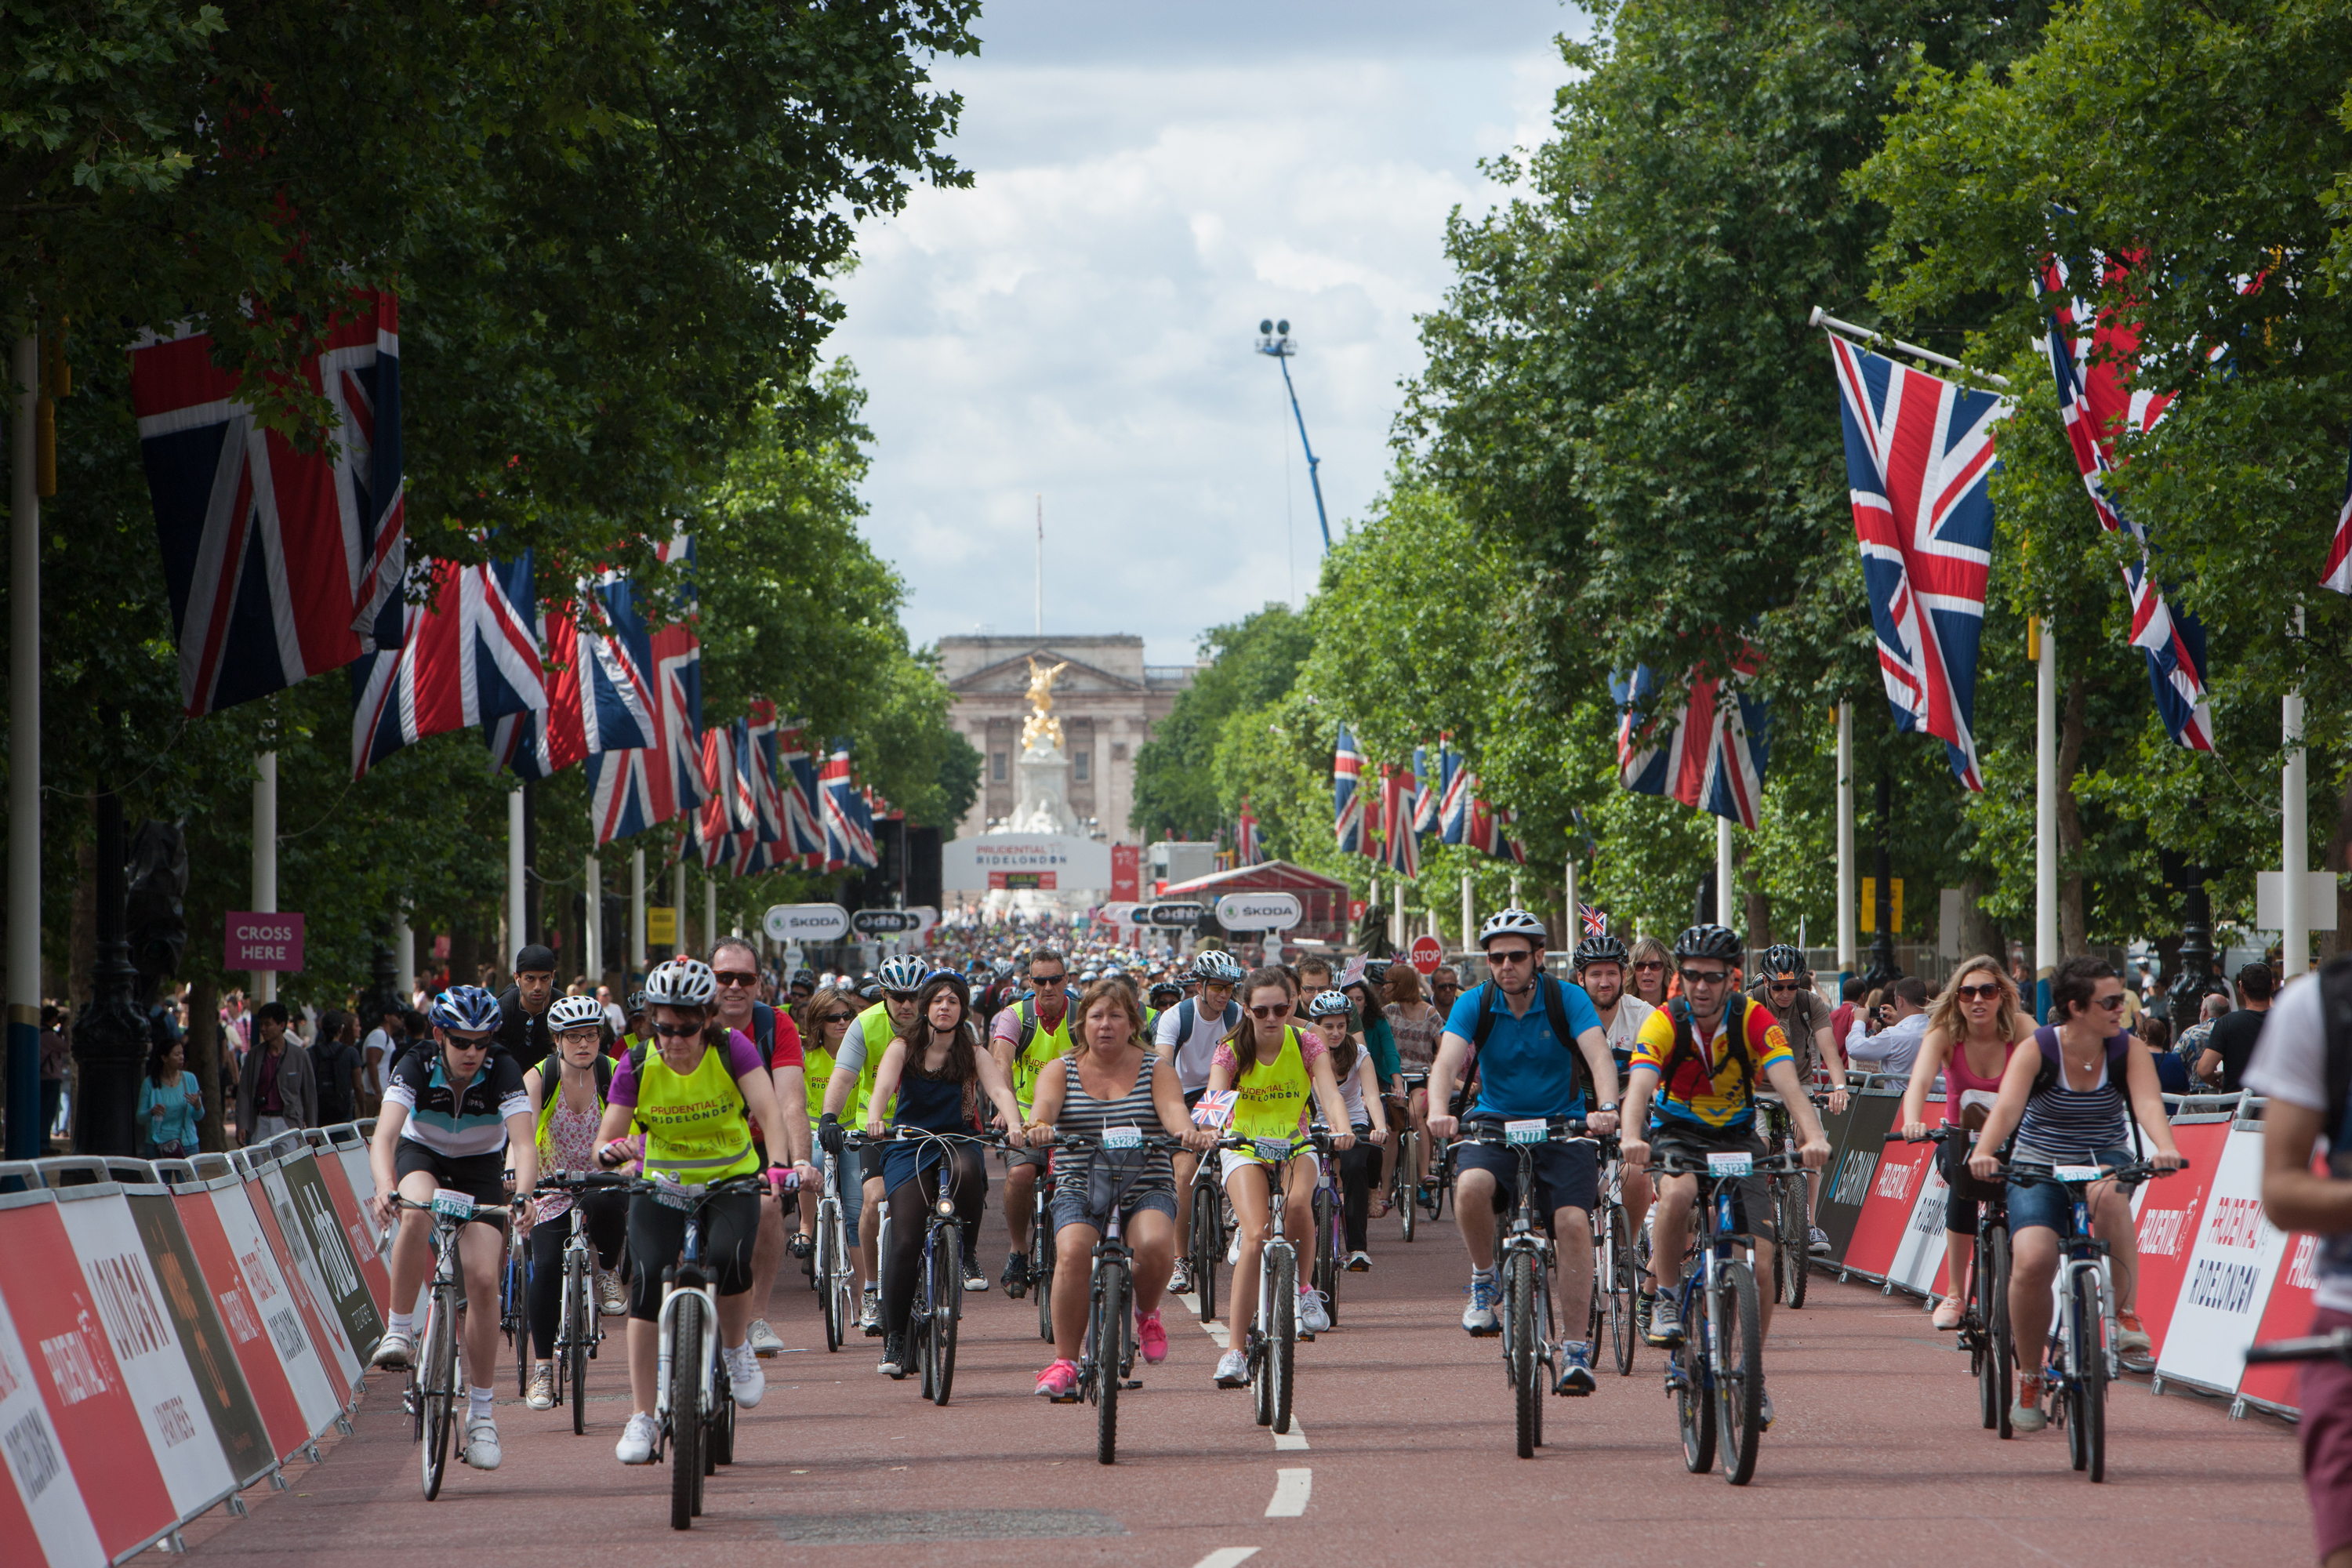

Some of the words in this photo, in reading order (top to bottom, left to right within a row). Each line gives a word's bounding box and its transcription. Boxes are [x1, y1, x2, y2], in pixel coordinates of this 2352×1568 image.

[976, 845, 1047, 855] PRUDENTIAL
[236, 926, 292, 941] CROSS
[241, 945, 286, 960] HERE
[1414, 949, 1440, 963] STOP
[1238, 1085, 1284, 1096] RUDENTIAL
[1238, 1091, 1300, 1102] IDELONDON
[651, 1100, 718, 1115] PRUDENTIAL
[651, 1102, 735, 1124] RIDELONDON
[1511, 1130, 1542, 1142] 34777
[1715, 1163, 1747, 1176] 36123
[1835, 1149, 1879, 1207] GARMIN
[1875, 1162, 1912, 1200] PRUDENTIAL
[436, 1200, 468, 1218] 34759
[2206, 1196, 2265, 1250] PRUDENTIAL
[303, 1181, 358, 1298] dhb
[2136, 1208, 2186, 1256] PRUDENTIAL
[241, 1250, 277, 1304] PRUDENTIAL
[2188, 1258, 2261, 1315] RIDELONDON
[86, 1253, 170, 1361] LONDON
[220, 1288, 258, 1345] PRUDENTIAL
[268, 1306, 307, 1363] RIDELONDON
[39, 1329, 107, 1407] PRUDENTIAL
